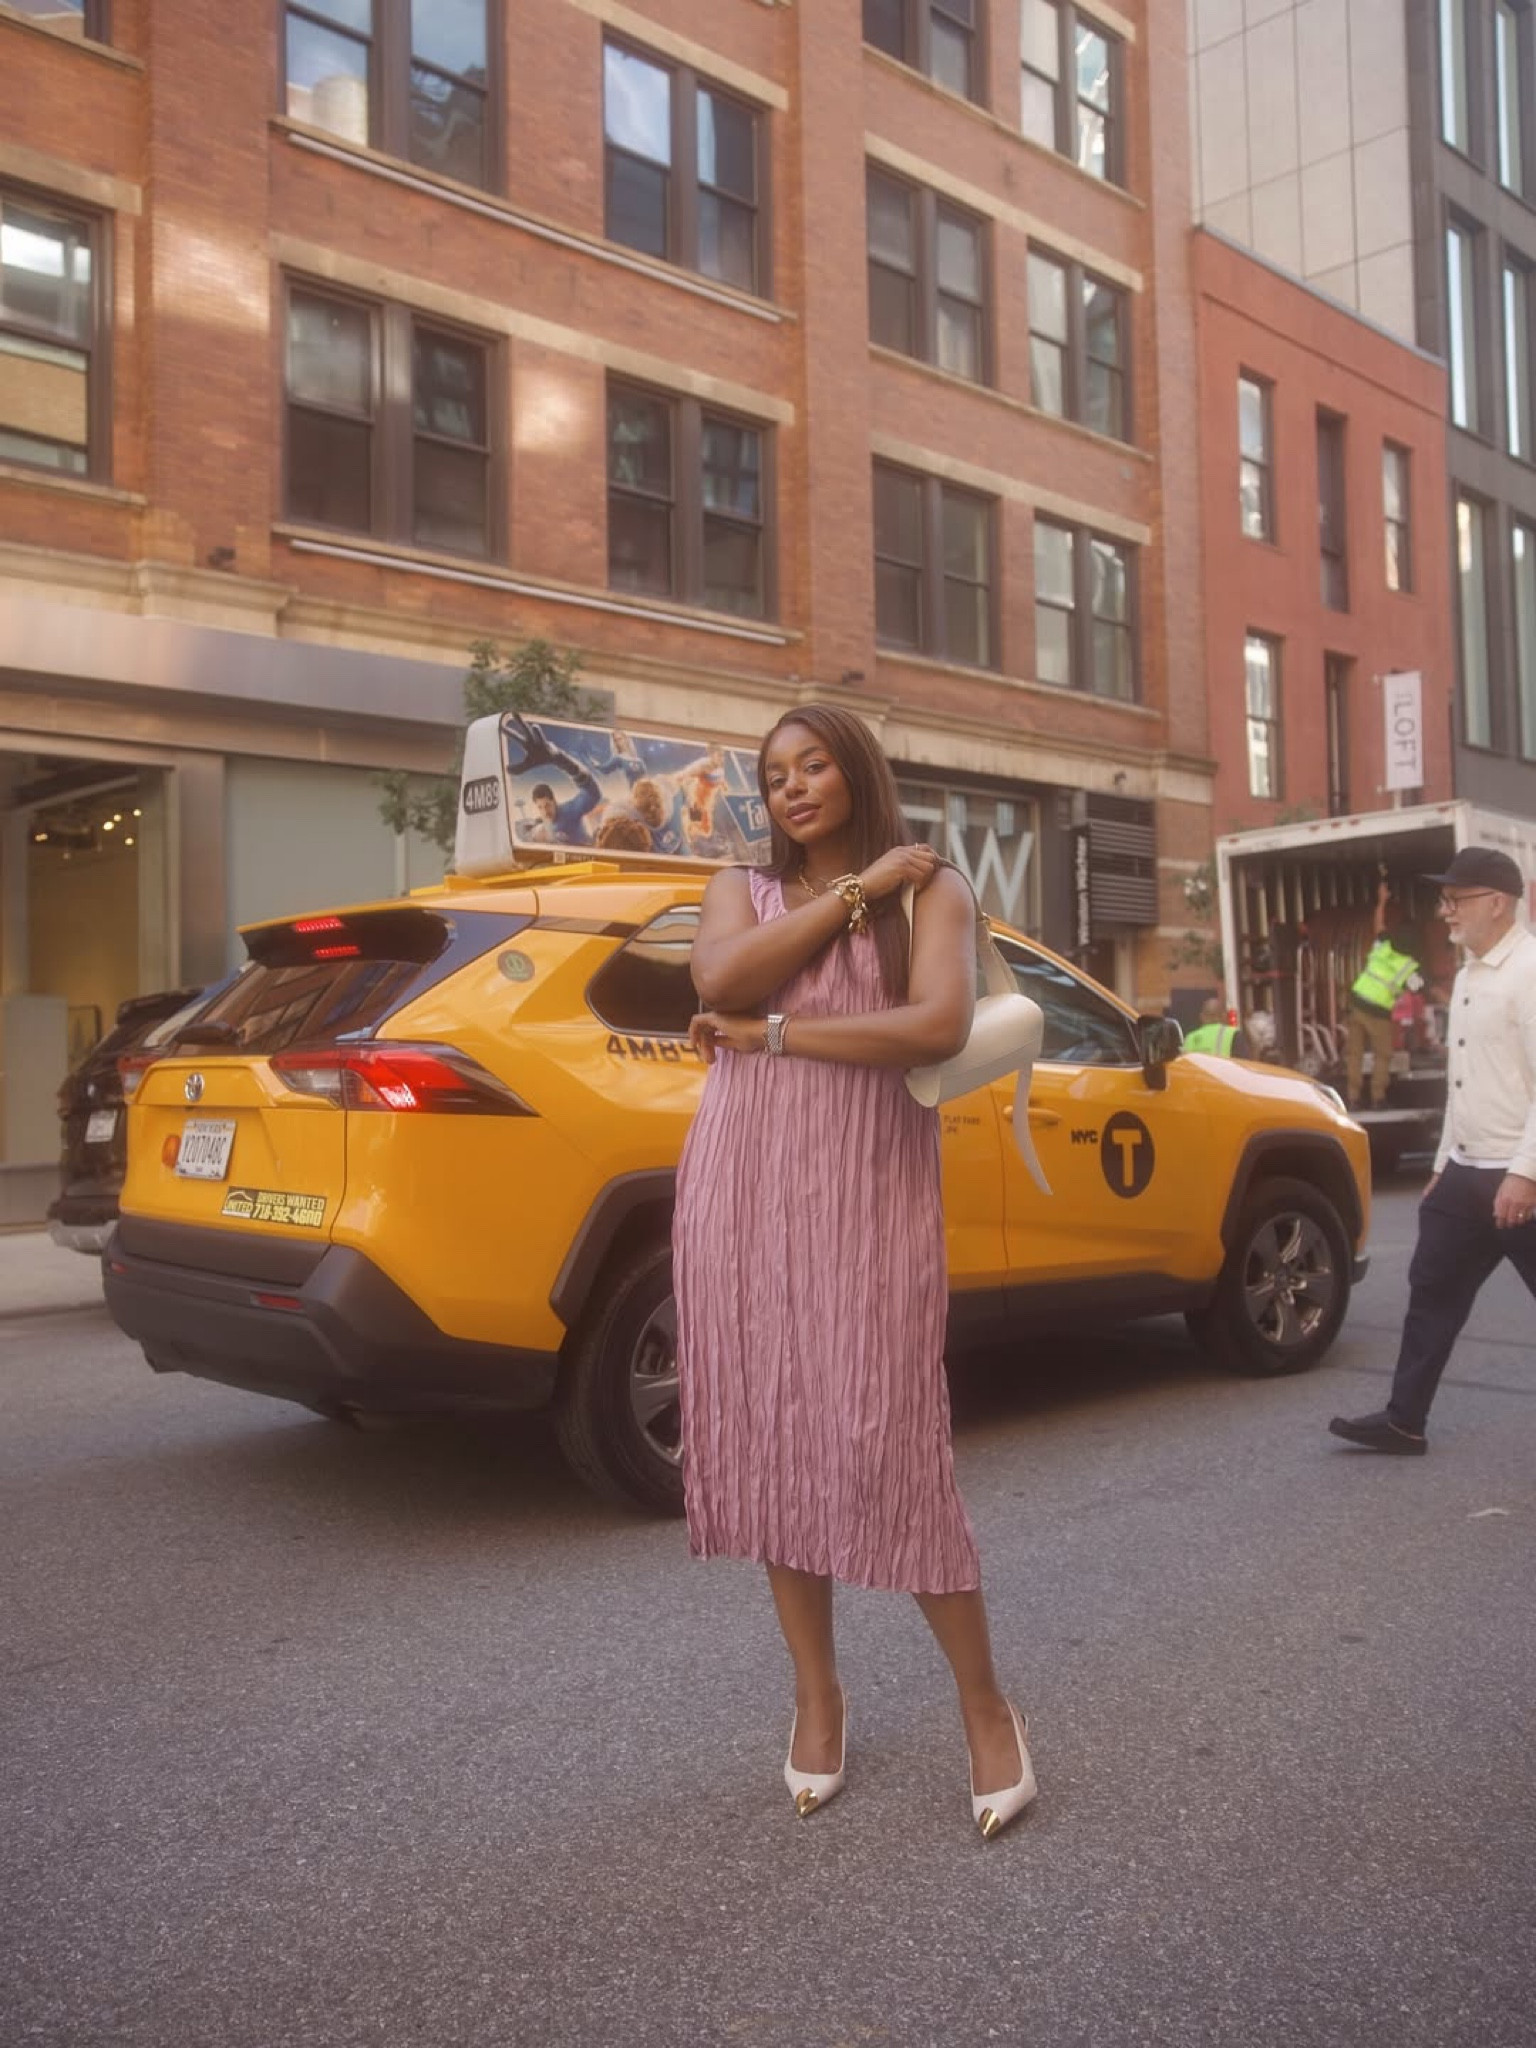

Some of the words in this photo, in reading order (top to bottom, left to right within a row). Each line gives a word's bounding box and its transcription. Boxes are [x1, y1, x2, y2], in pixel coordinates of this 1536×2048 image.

[465, 781, 499, 811] 4M89
[1071, 1128, 1099, 1145] NYC
[1112, 1128, 1143, 1188] T
[257, 1191, 286, 1206] DRIVERS
[286, 1193, 325, 1210] WANTED
